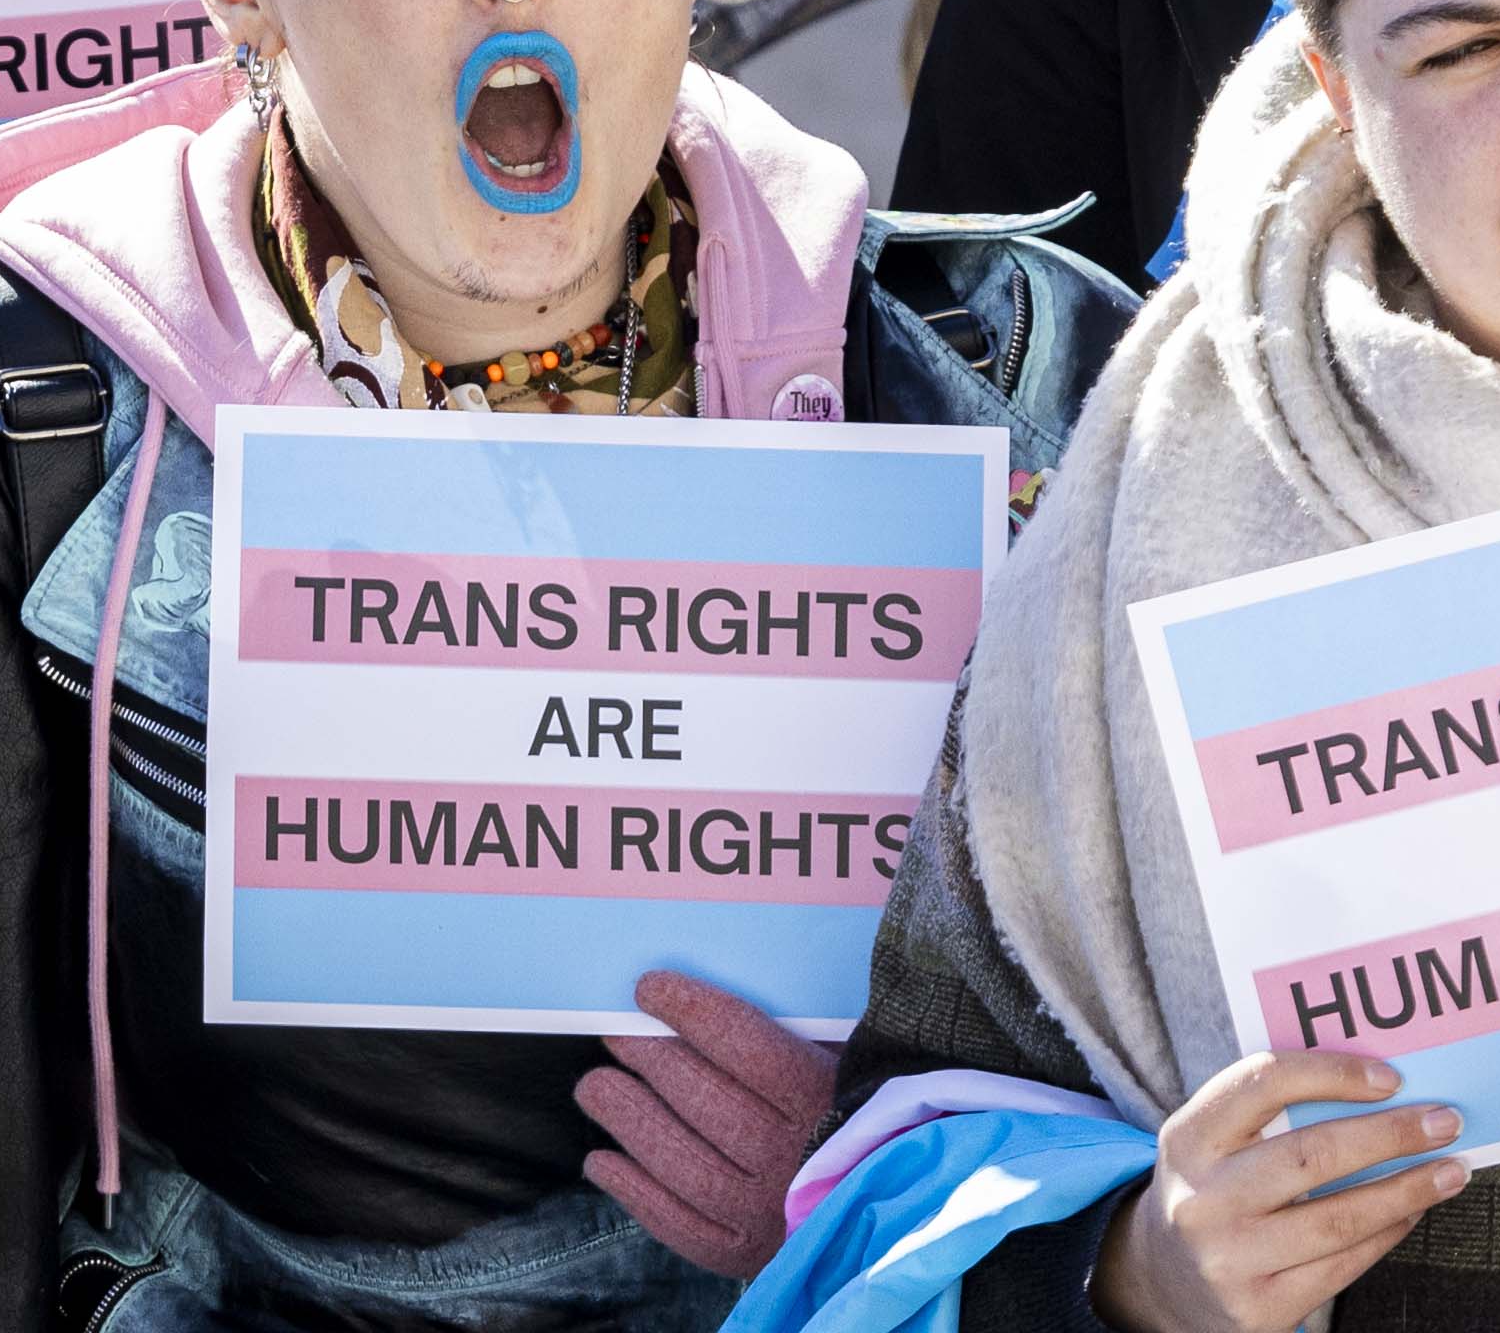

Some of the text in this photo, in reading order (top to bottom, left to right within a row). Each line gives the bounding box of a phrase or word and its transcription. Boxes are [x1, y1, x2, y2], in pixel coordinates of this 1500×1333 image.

[790, 391, 832, 419] They
[294, 576, 925, 661] TRANS RIGHTS
[527, 696, 684, 761] ARE
[264, 796, 914, 880] HUMAN RIGHTS
